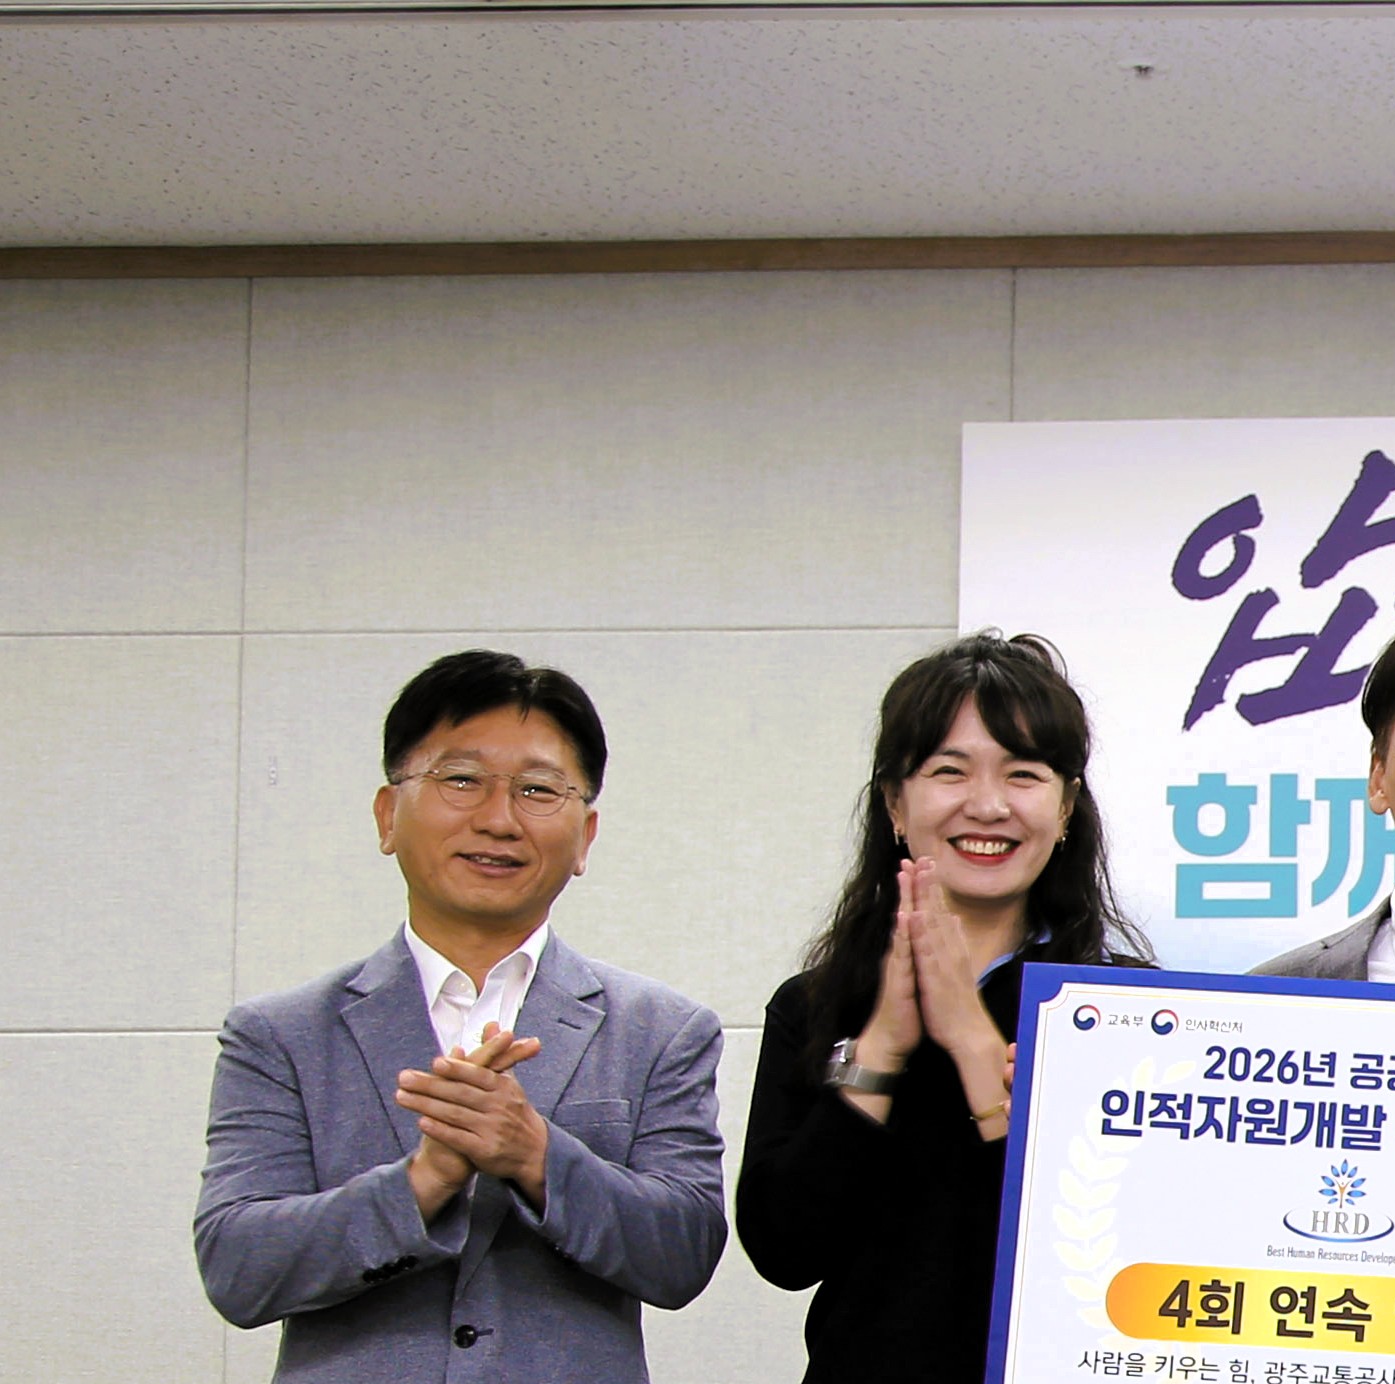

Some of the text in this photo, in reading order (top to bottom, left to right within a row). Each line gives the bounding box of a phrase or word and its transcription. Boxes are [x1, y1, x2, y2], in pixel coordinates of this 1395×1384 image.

[1109, 1015, 1143, 1026] 교육부
[1186, 1019, 1242, 1032] 인사혁신처
[1204, 1046, 1336, 1087] 2026년
[1101, 1090, 1387, 1151] 인적자원개발
[1312, 1211, 1369, 1234] HRD
[1266, 1245, 1285, 1258] Best
[1287, 1246, 1315, 1259] Human
[1317, 1248, 1359, 1262] Resources
[1159, 1279, 1244, 1334] 4회
[1270, 1286, 1371, 1342] 연속
[1078, 1351, 1146, 1377] 사람을
[1155, 1355, 1220, 1381] 키우는
[1229, 1359, 1254, 1384] 힘,
